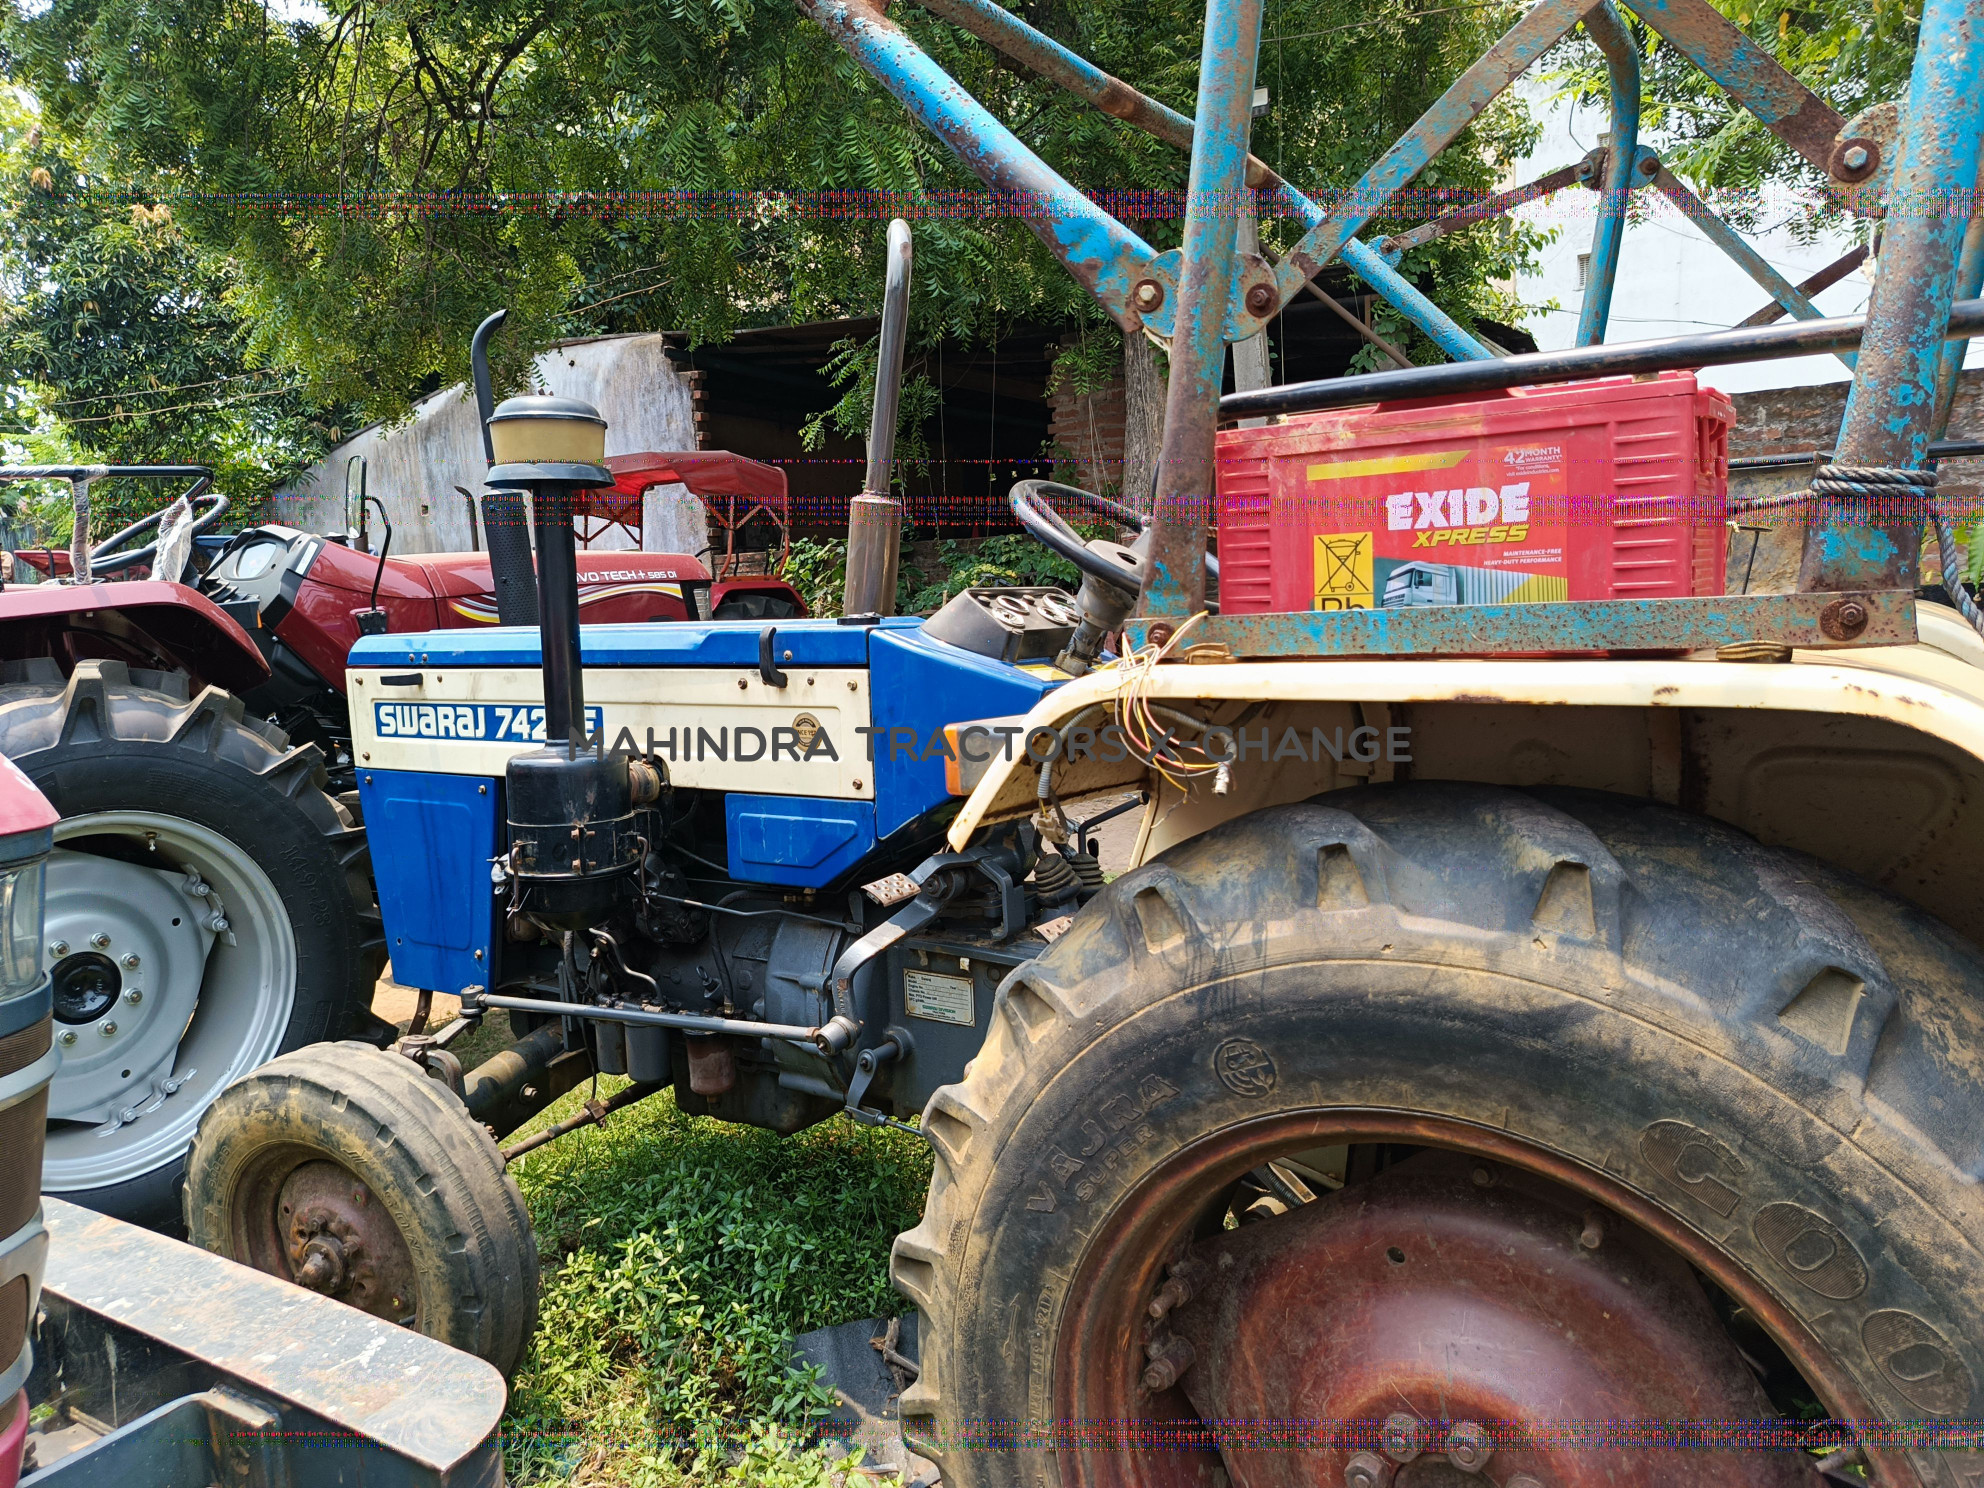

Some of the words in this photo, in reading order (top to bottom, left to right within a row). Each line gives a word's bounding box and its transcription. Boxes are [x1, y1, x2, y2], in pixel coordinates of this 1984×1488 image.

[1525, 446, 1560, 457] MONTH
[1386, 482, 1530, 530] EXIDE
[1411, 524, 1530, 548] XPRESS
[1483, 558, 1519, 566] HEAVY-DUTY
[1519, 556, 1562, 564] PERFORMANCE
[1503, 548, 1562, 557] MAINTENANCE-FREE
[647, 571, 667, 579] 585
[1026, 1073, 1180, 1214] VAJRA
[1075, 1123, 1155, 1202] SUPER
